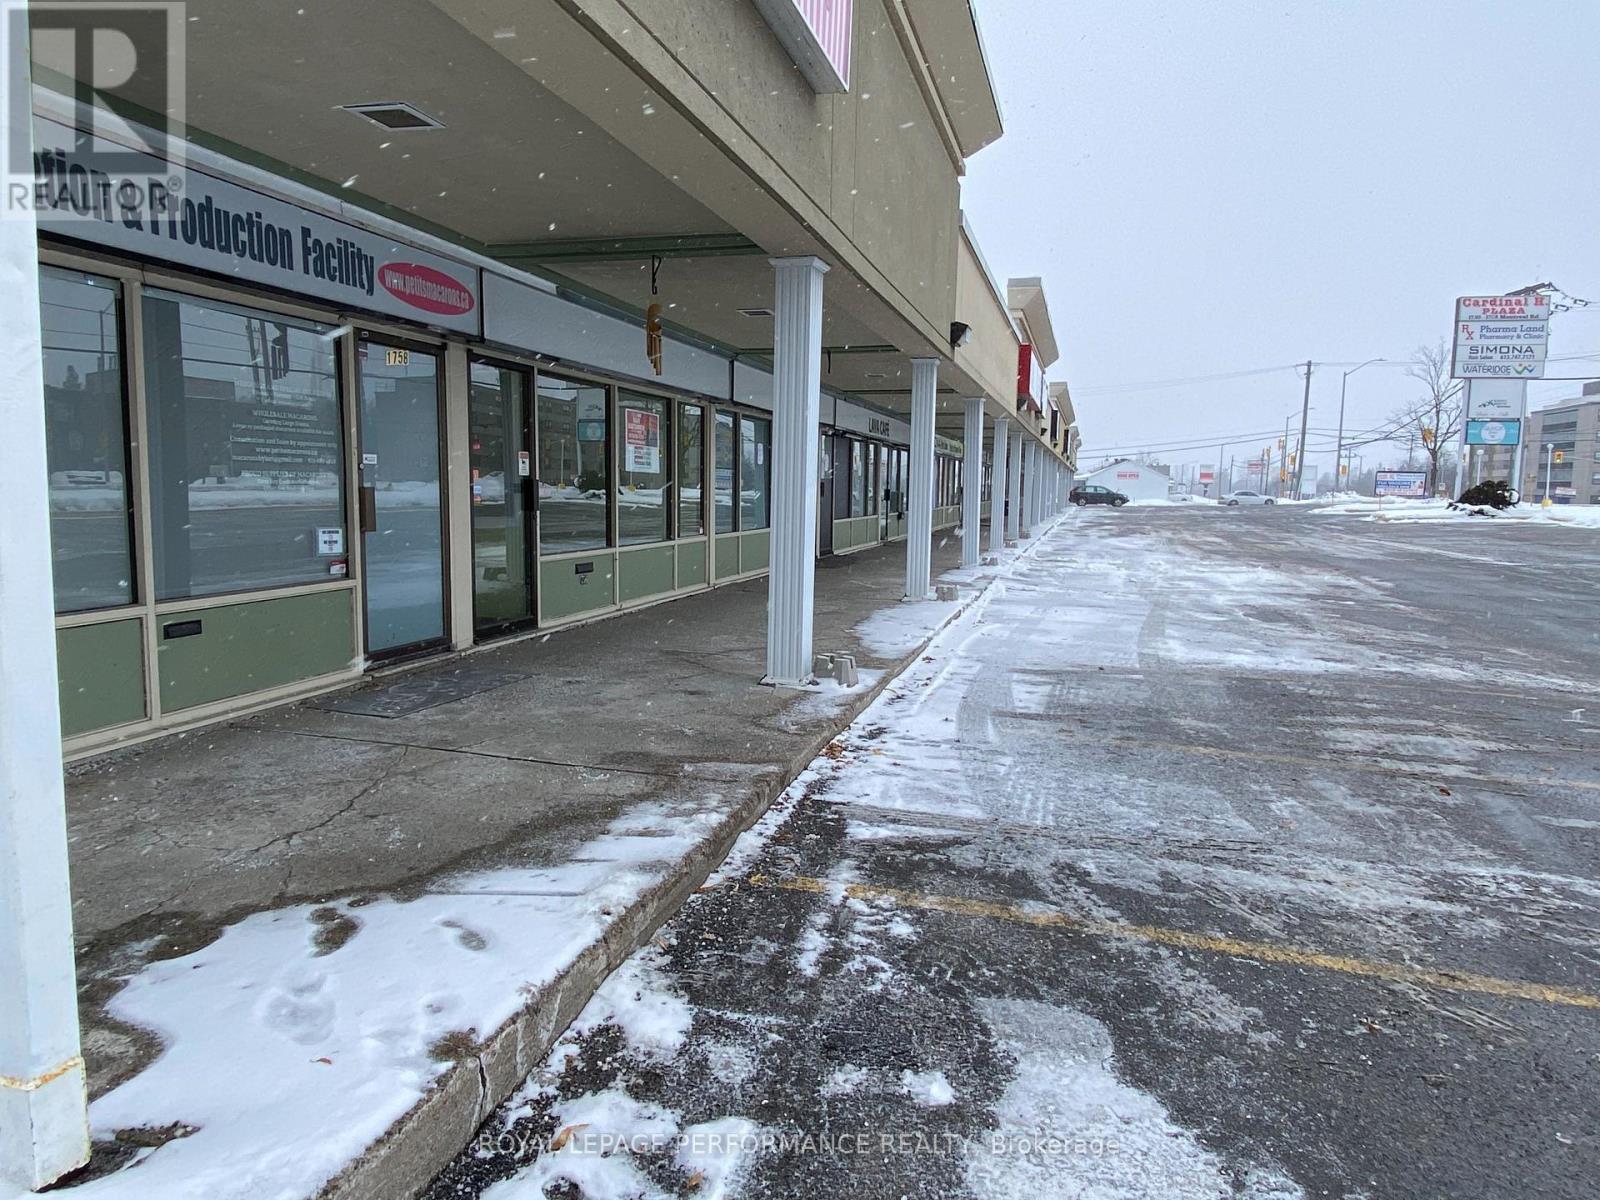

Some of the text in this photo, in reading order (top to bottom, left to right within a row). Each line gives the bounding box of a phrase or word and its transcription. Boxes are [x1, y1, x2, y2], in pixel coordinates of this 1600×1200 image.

[120, 179, 143, 231] &
[148, 177, 294, 271] Production
[300, 226, 374, 296] Facility
[1462, 296, 1528, 307] Cardinal
[1482, 307, 1526, 315] PLAZA
[1480, 325, 1517, 333] Pharma
[1469, 346, 1534, 354] SIMONA
[387, 351, 408, 364] 1758
[1462, 365, 1511, 373] WATERIDGE
